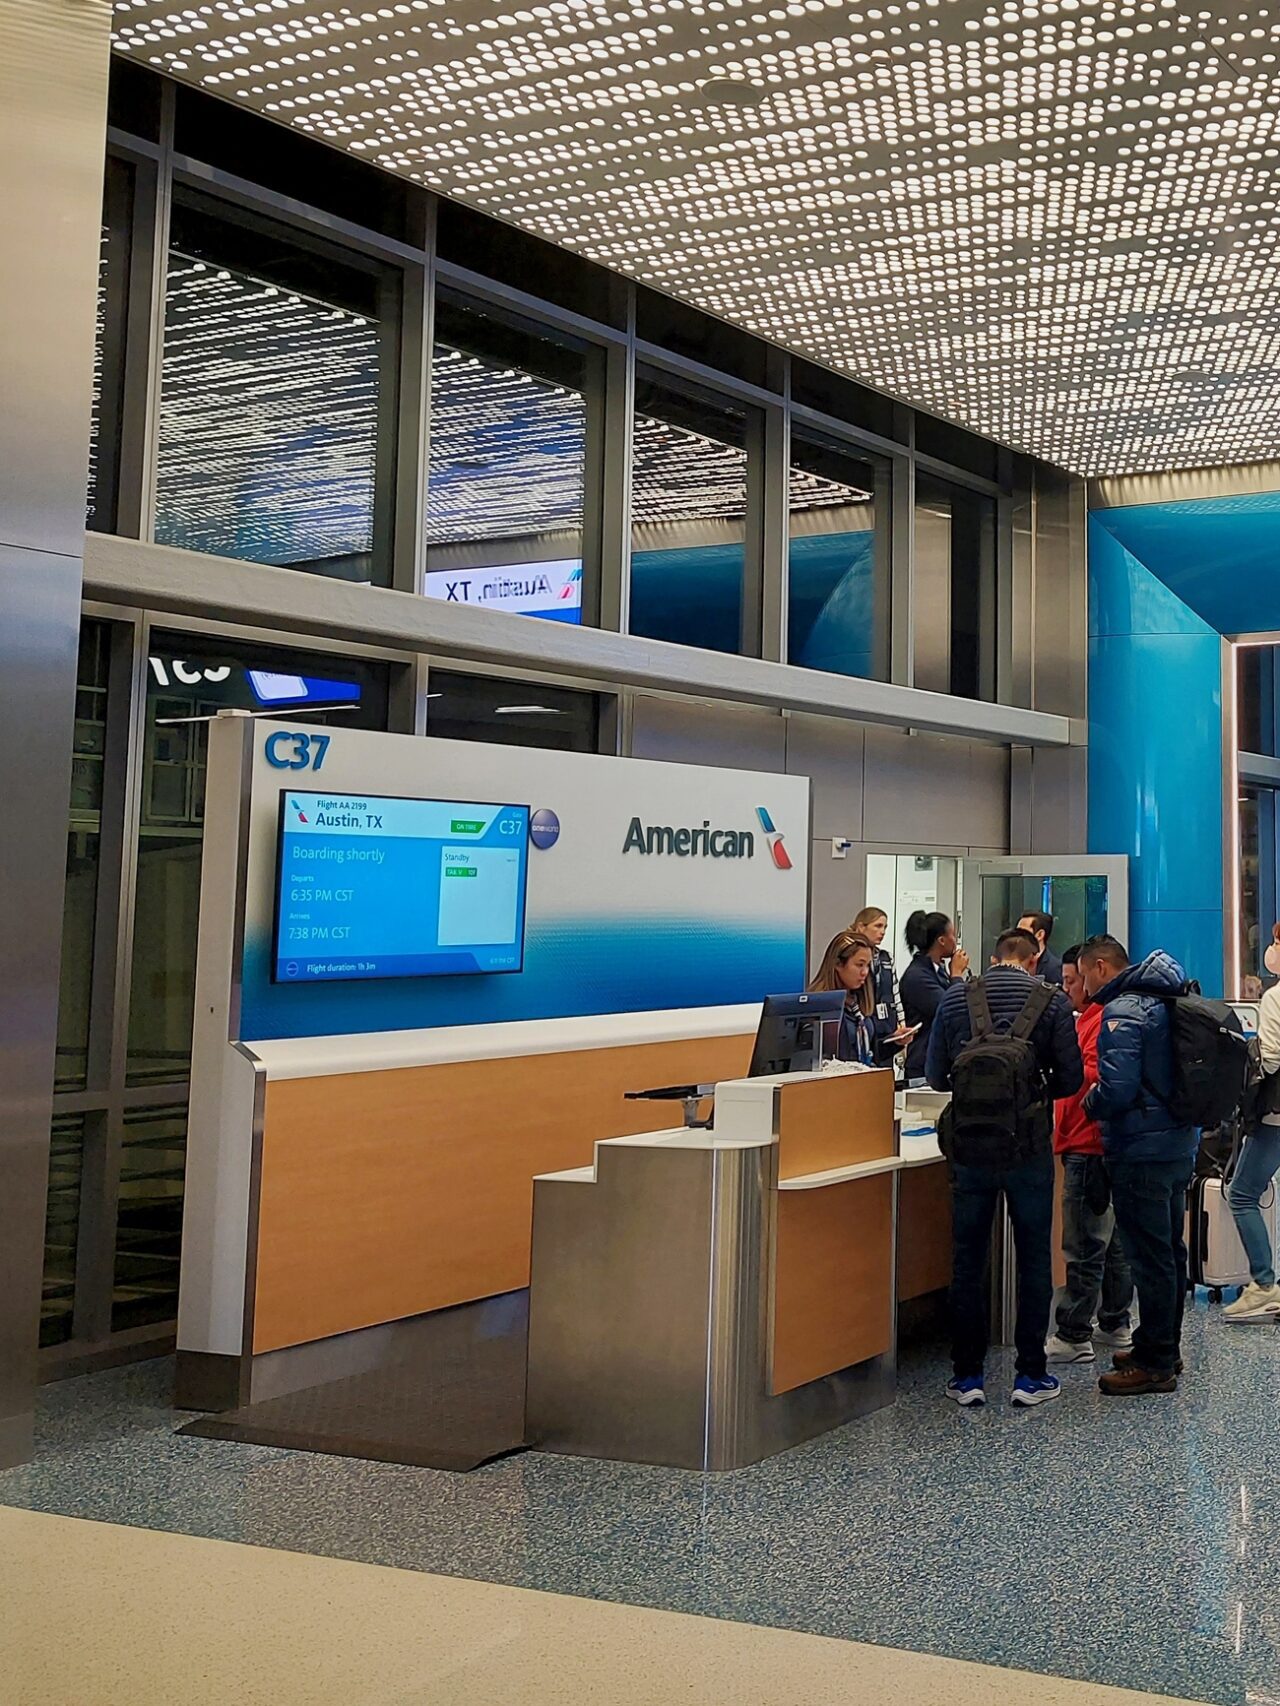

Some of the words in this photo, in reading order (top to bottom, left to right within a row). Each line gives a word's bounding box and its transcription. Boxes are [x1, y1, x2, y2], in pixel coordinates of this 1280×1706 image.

[264, 731, 331, 771] C37
[317, 800, 338, 812] Flight
[338, 801, 350, 810] AA
[350, 802, 367, 811] 2199
[315, 812, 363, 829] Austin,
[366, 815, 383, 829] TX
[499, 820, 523, 836] C37
[622, 816, 754, 859] American
[292, 845, 344, 862] Boarding
[345, 848, 385, 866] shortly
[444, 853, 470, 864] Standby
[315, 889, 332, 902] PM
[335, 888, 355, 902] CST
[311, 927, 329, 940] PM
[331, 926, 352, 939] CST
[306, 963, 326, 975] Flight
